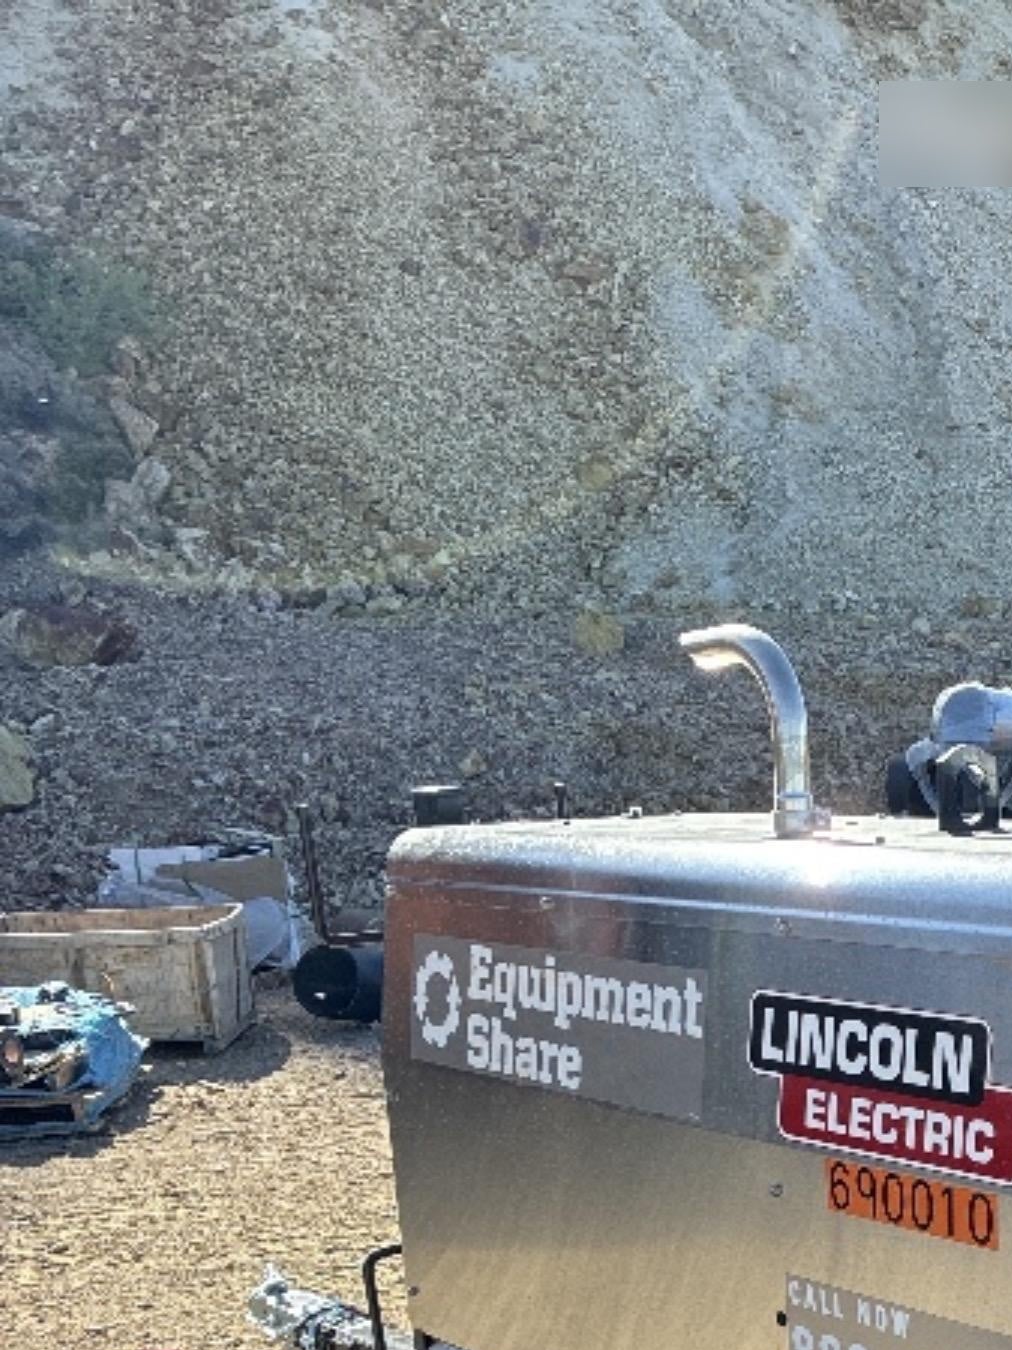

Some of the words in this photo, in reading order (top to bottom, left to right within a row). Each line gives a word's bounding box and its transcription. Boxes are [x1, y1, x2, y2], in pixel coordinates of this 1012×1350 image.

[467, 944, 703, 1039] Equipment
[466, 1013, 583, 1090] Share
[761, 1007, 974, 1094] LINCOLN
[804, 1088, 995, 1164] ELECTRIC
[829, 1160, 995, 1246] 690010
[788, 1279, 844, 1320] CALL
[857, 1298, 911, 1339] NOW
